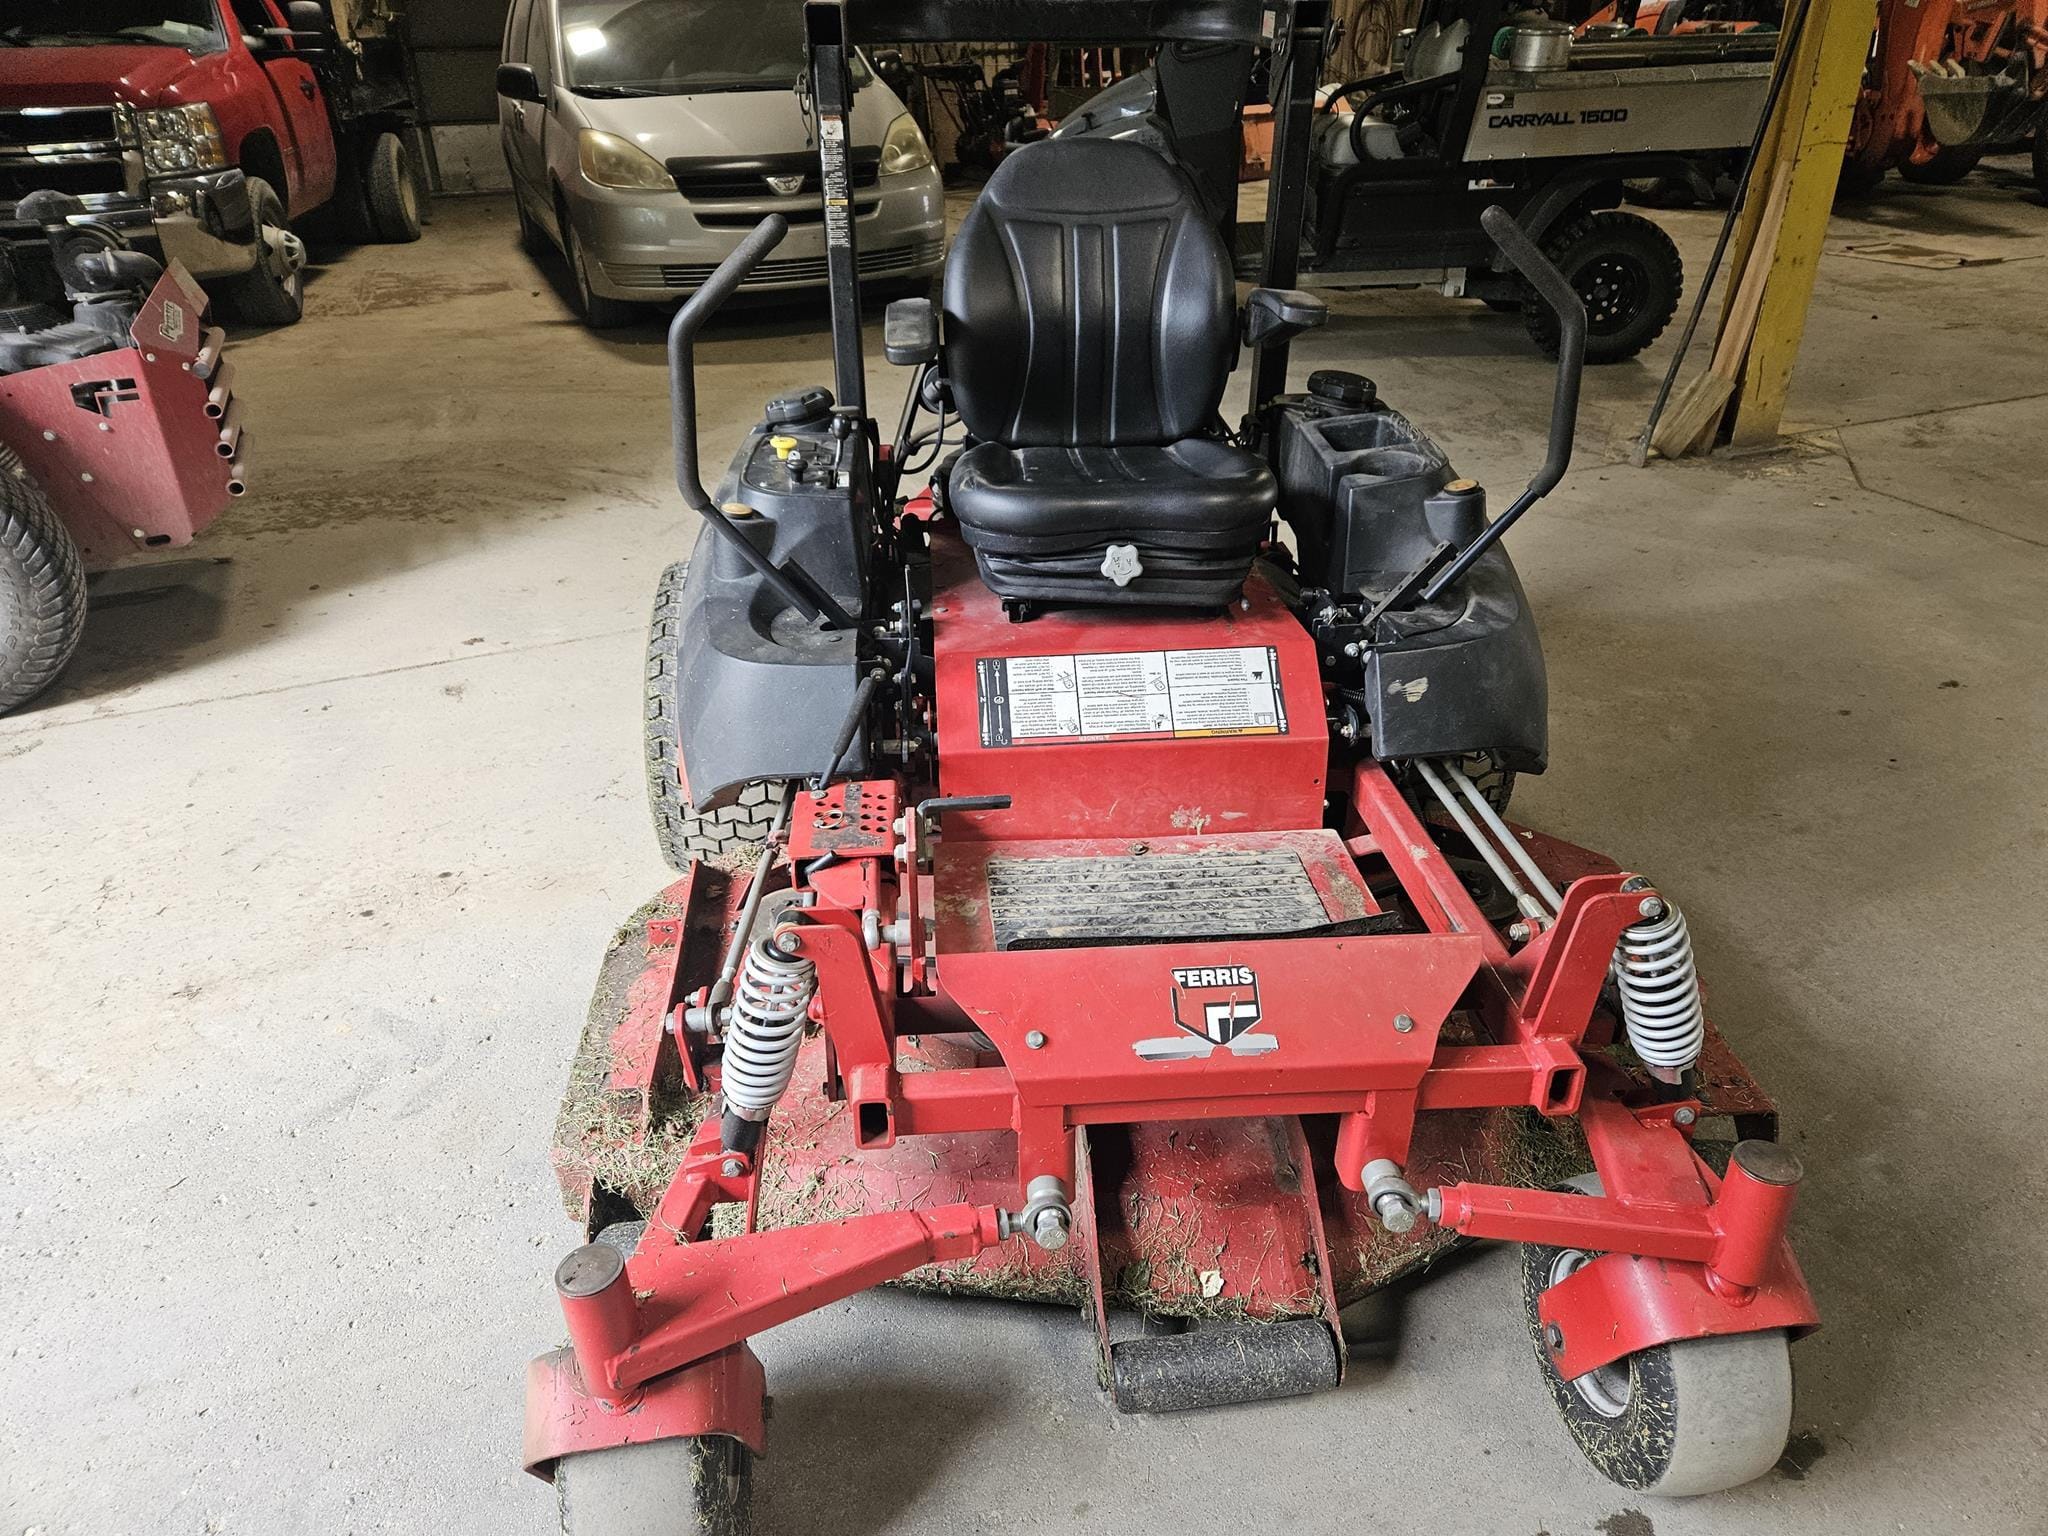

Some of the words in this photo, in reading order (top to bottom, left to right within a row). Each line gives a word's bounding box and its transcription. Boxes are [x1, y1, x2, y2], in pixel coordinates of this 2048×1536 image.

[1488, 112, 1575, 128] CARRYALL
[1580, 109, 1628, 124] 1500
[1174, 967, 1254, 987] FERRIS
